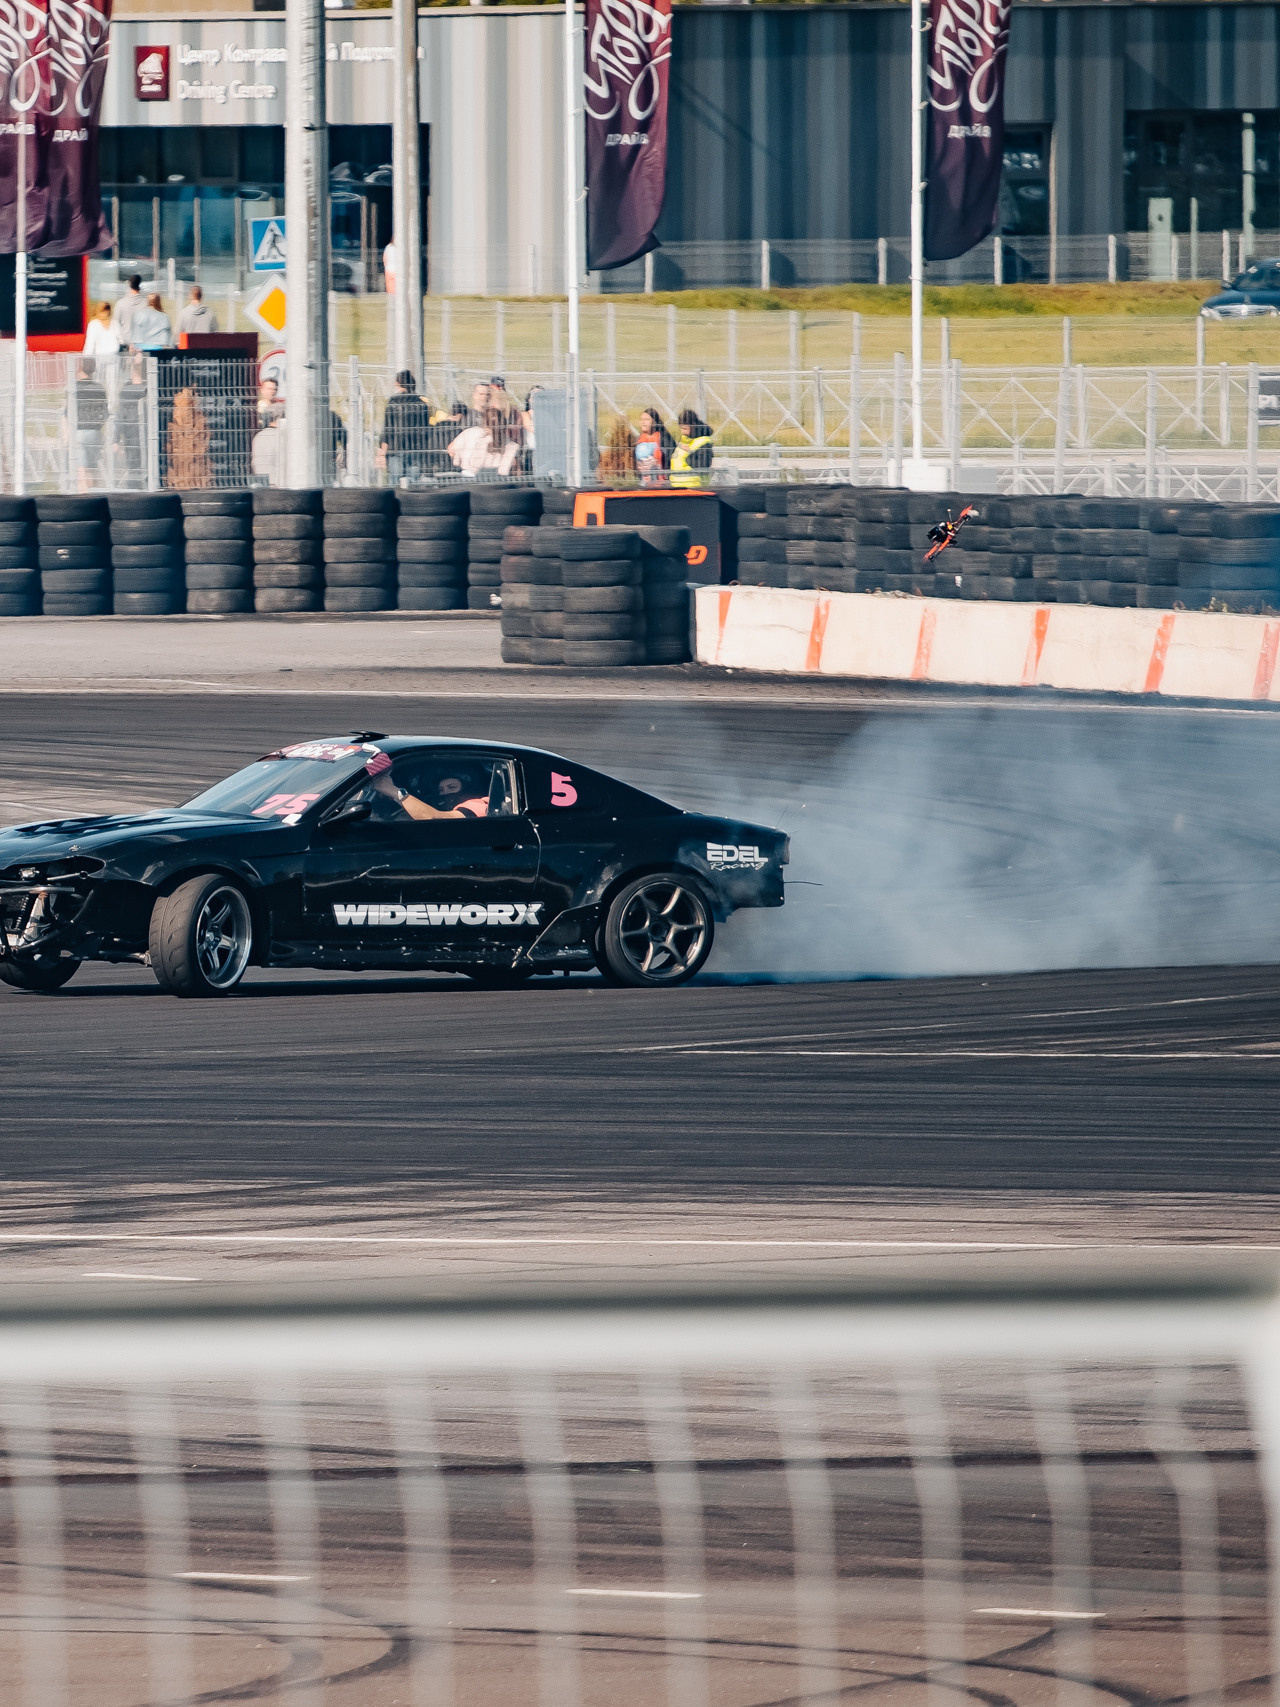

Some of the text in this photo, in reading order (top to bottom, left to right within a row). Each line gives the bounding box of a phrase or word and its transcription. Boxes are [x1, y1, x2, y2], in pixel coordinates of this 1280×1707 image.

[52, 128, 89, 143] ДРАЙ
[550, 771, 578, 807] 5
[251, 793, 320, 815] 75
[706, 842, 769, 862] EDEL
[333, 903, 542, 926] WIDEWORX
